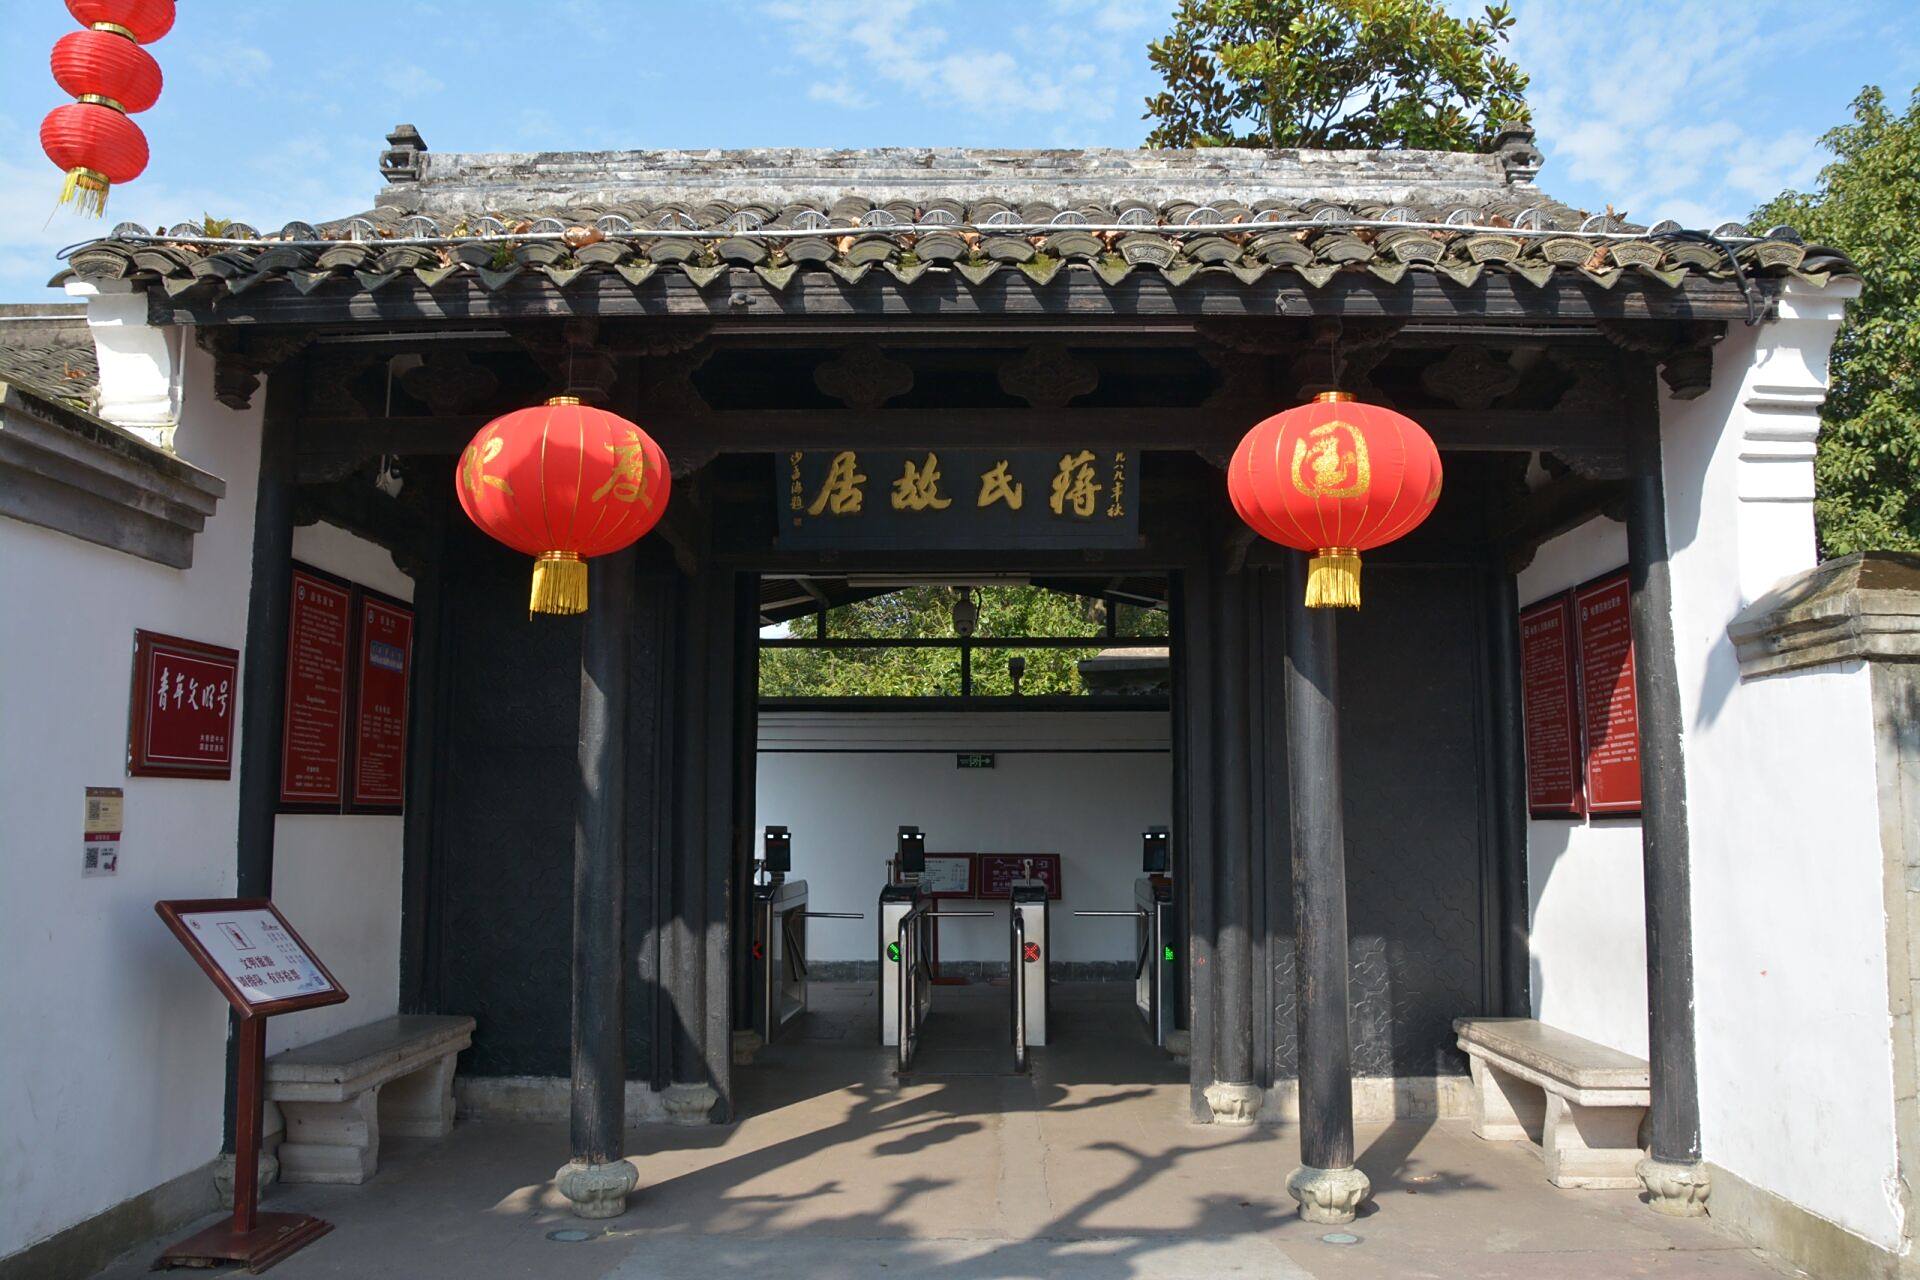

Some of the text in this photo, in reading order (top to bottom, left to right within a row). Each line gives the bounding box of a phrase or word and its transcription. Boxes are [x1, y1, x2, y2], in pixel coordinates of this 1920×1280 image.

[157, 666, 229, 717] 青年文明号
